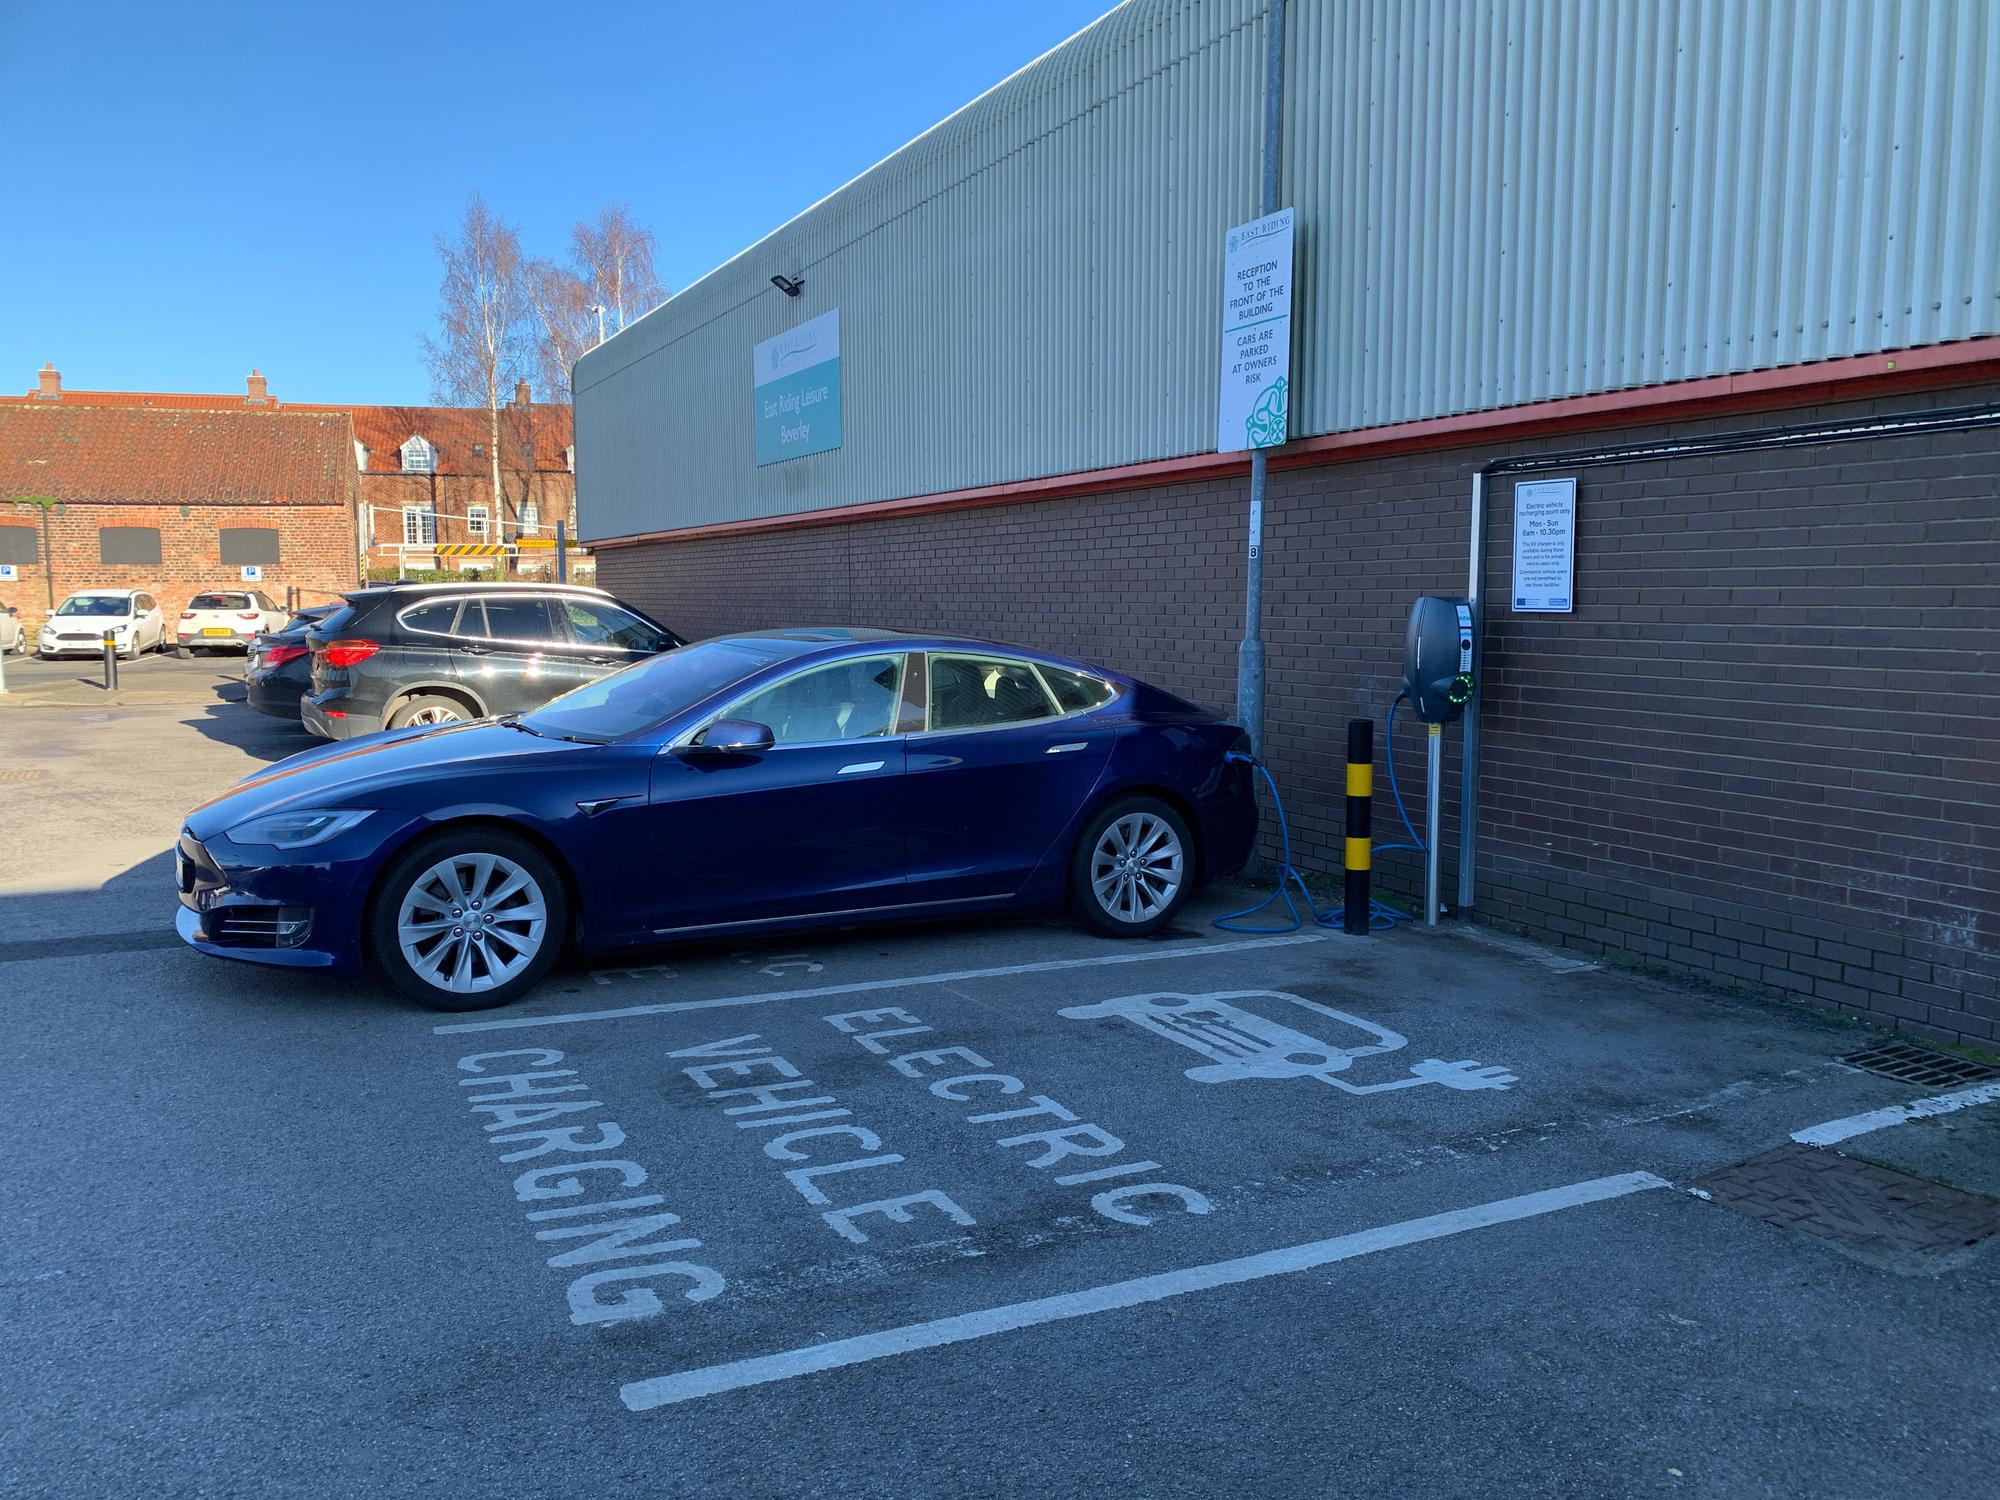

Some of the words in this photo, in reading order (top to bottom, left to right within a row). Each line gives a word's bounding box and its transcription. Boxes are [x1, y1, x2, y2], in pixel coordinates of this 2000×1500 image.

[1242, 226, 1259, 240] EAST
[1237, 260, 1278, 281] RECEPTION
[1243, 282, 1253, 292] TO
[1256, 276, 1270, 288] THE
[1230, 294, 1254, 310] FRONT
[1256, 290, 1266, 301] OF
[1269, 285, 1284, 298] THE
[1239, 302, 1273, 320] BUILDING
[1237, 334, 1256, 346] CARS
[1259, 329, 1273, 341] ARE
[1240, 344, 1268, 359] PARKED
[1232, 364, 1242, 374] AT
[1245, 356, 1277, 371] OWNERS
[1246, 373, 1261, 384] RISK
[764, 400, 778, 418] East
[780, 394, 800, 415] Riding
[802, 386, 828, 407] Leisure
[781, 421, 810, 444] Beverley
[1251, 548, 1256, 557] 8
[822, 1006, 1211, 1225] ELECTRIC
[666, 1034, 977, 1243] VEHICLE
[457, 1048, 726, 1327] CHARGING
